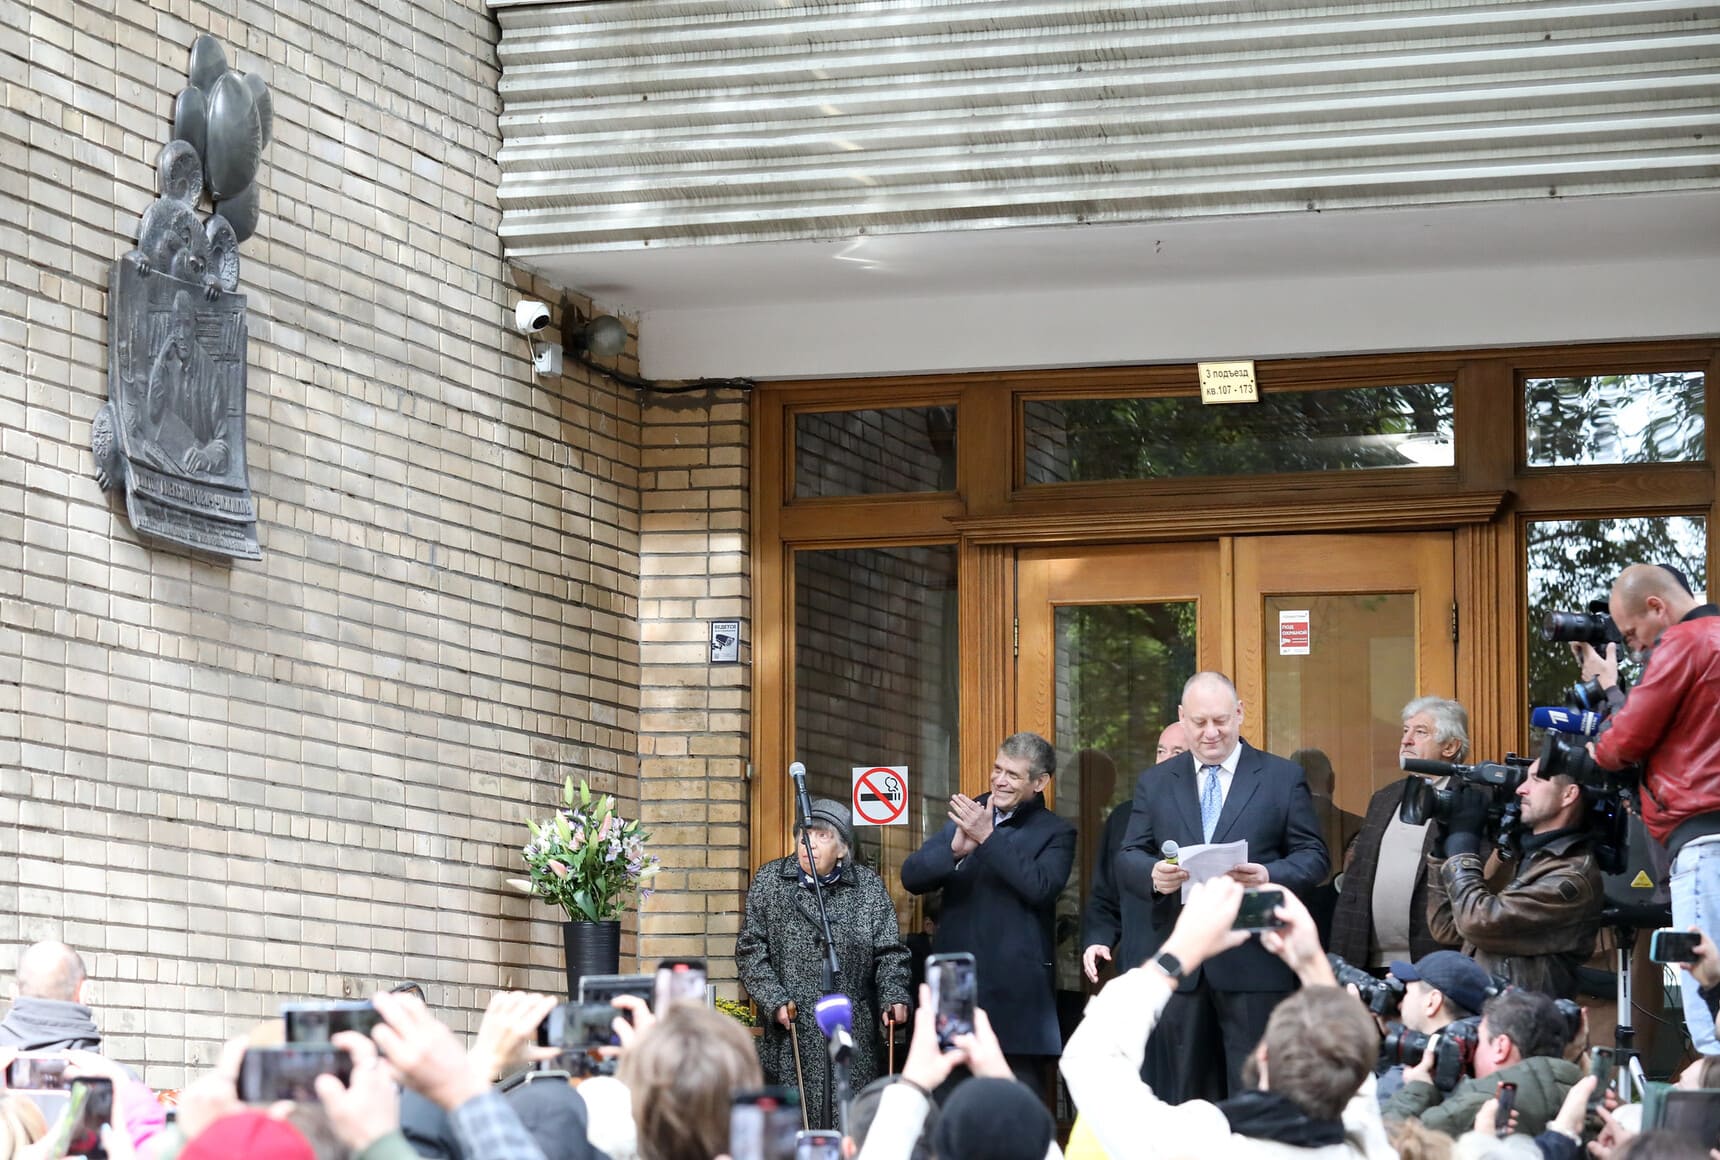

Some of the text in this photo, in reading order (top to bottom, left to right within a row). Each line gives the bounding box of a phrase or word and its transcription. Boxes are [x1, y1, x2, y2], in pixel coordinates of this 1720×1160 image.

[1206, 369, 1249, 379] 3 подъезд
[1240, 384, 1254, 394] 173
